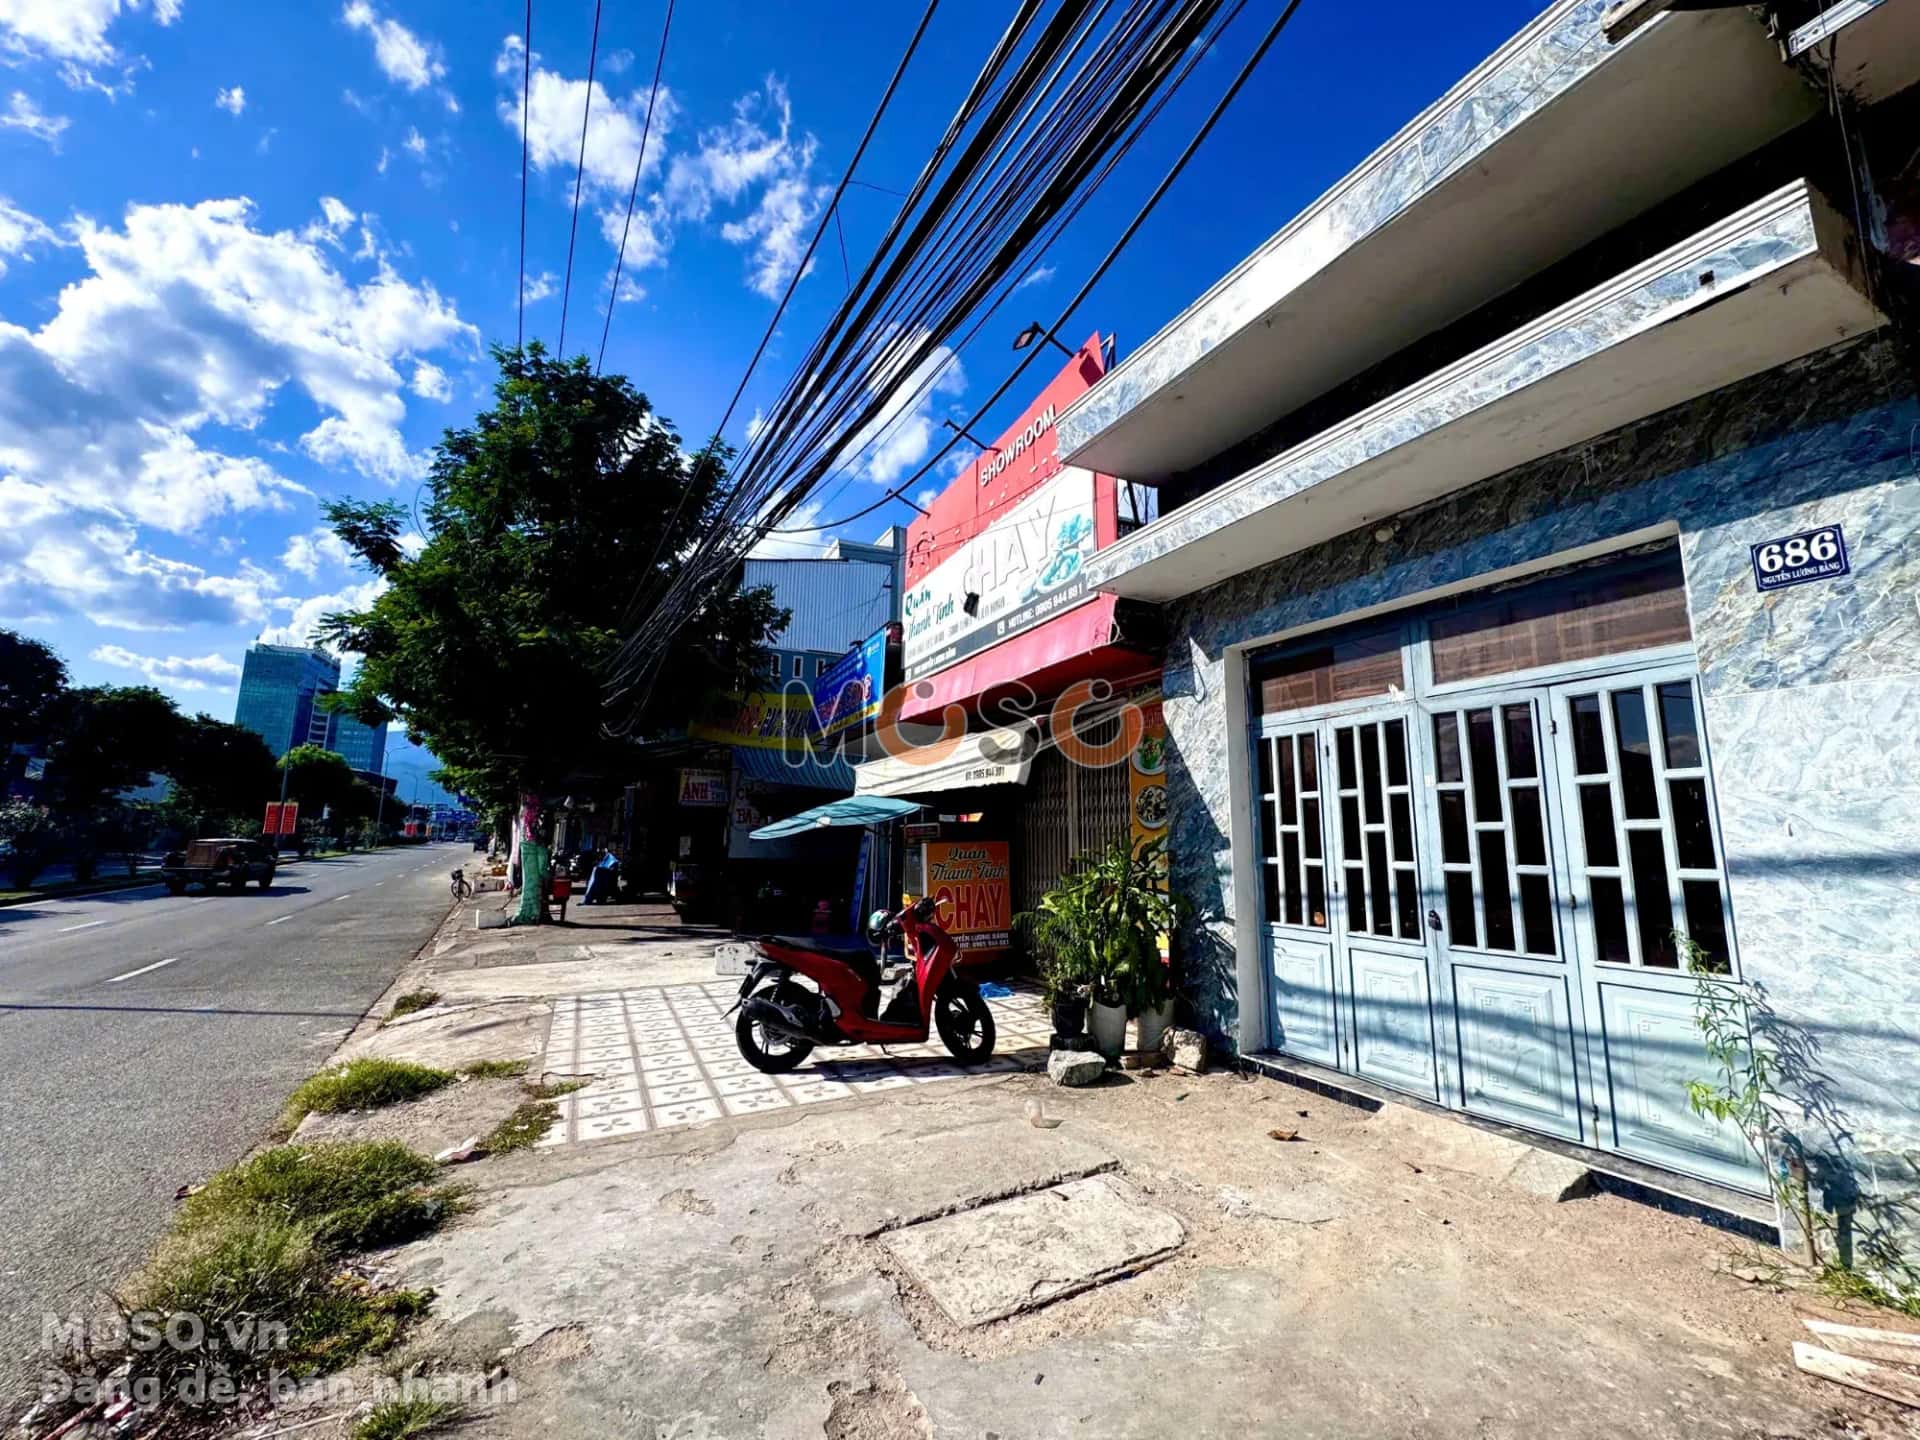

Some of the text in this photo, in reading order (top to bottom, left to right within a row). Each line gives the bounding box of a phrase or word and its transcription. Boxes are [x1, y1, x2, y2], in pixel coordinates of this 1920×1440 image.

[980, 403, 1056, 487] SHOWROOM
[1758, 531, 1838, 573] 686
[935, 883, 1004, 931] CHAY
